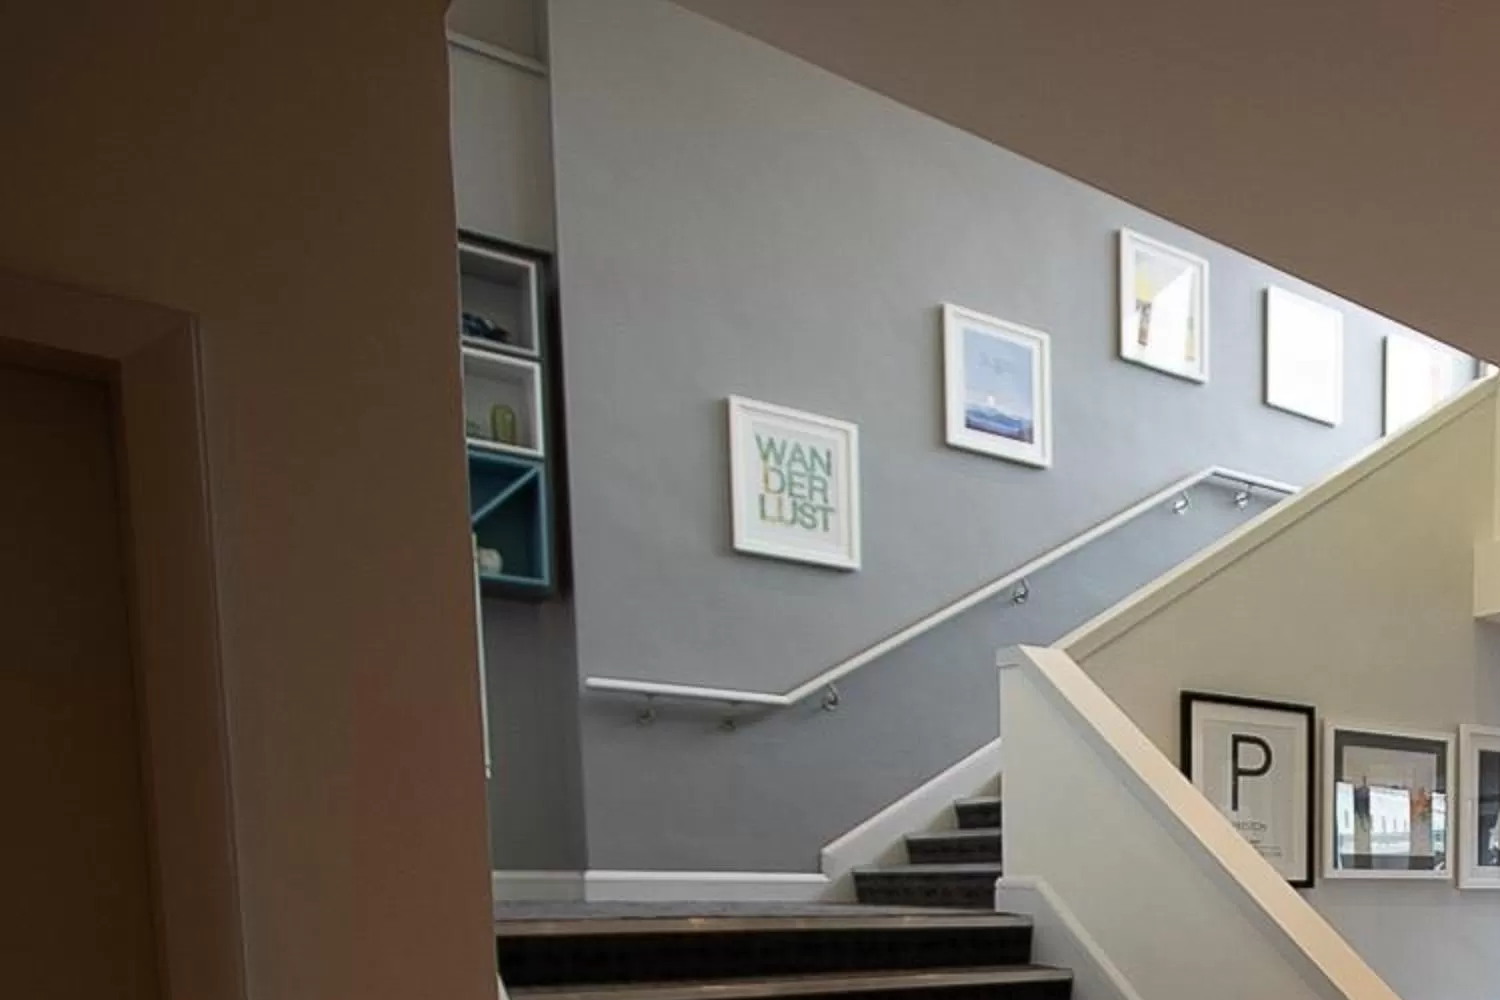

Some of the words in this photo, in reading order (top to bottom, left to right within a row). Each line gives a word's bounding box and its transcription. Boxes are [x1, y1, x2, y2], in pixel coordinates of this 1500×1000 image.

[755, 434, 833, 477] WAN
[763, 465, 829, 504] DER
[758, 493, 835, 532] LUST
[1231, 733, 1273, 811] P
